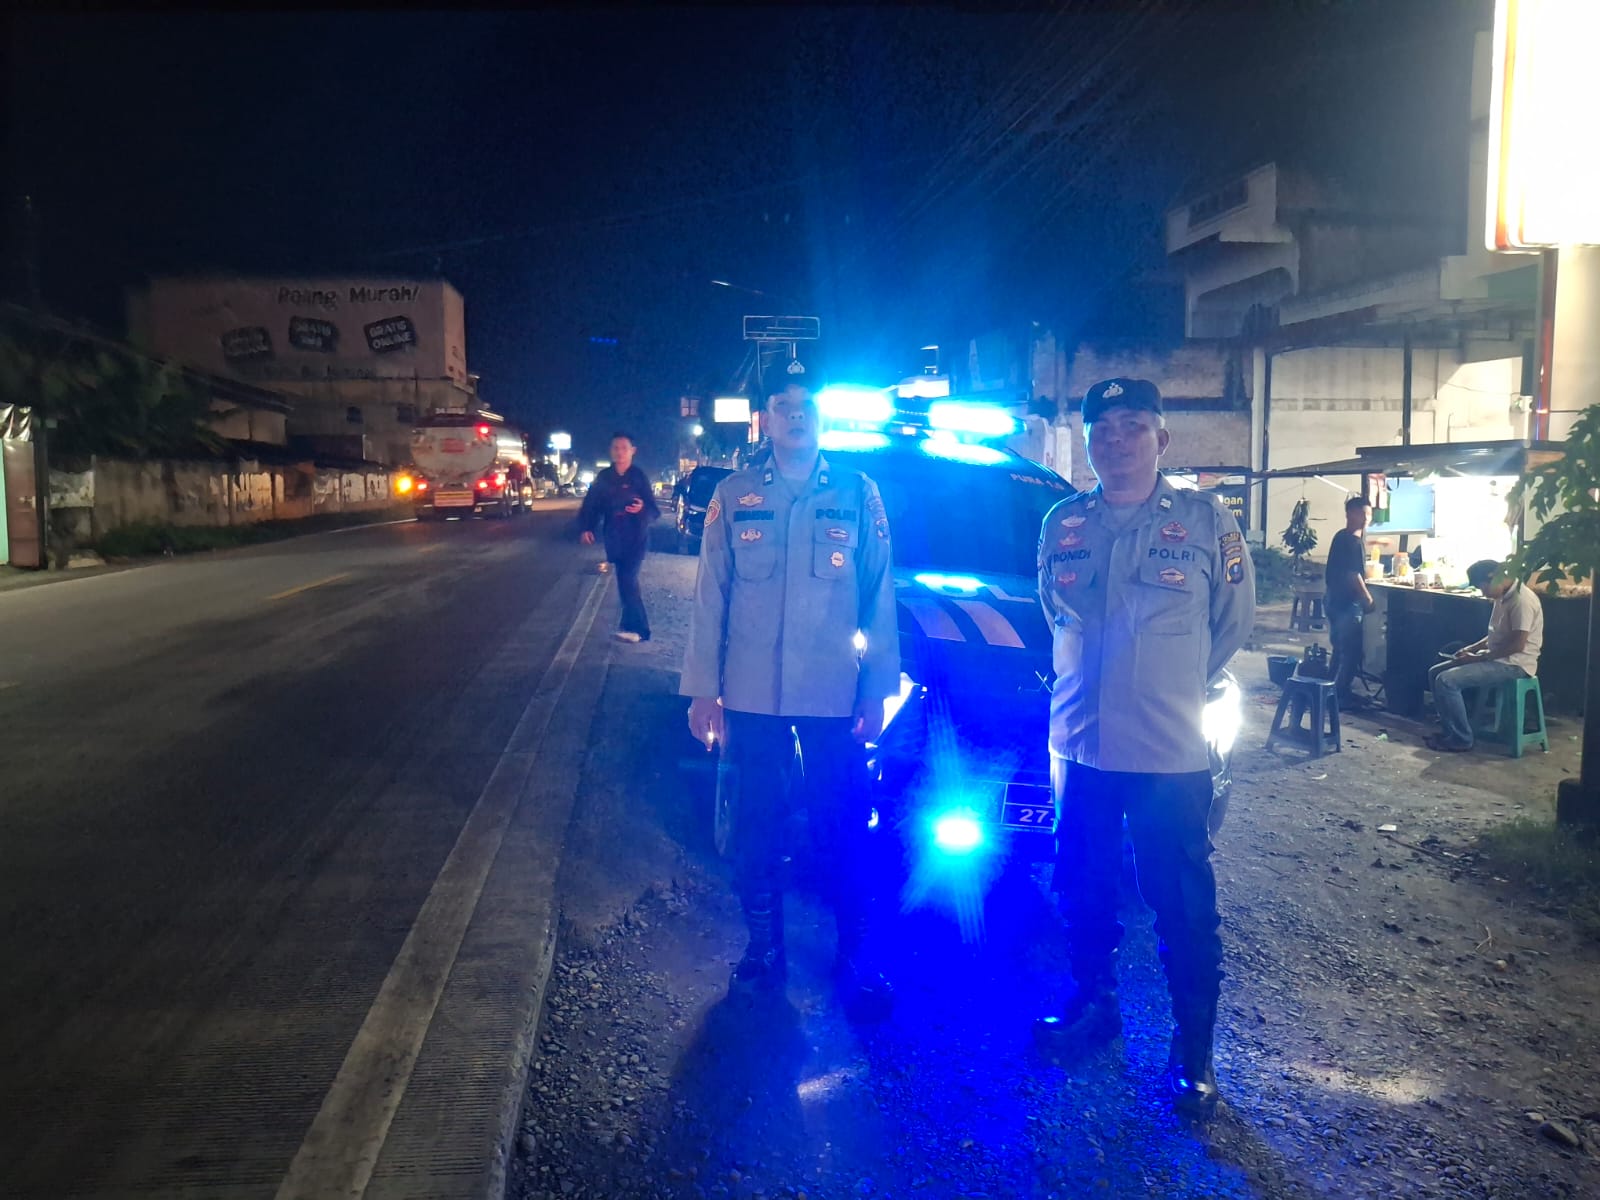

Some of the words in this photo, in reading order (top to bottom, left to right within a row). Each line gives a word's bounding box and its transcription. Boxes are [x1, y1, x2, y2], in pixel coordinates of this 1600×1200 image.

[278, 286, 338, 311] Paling
[1223, 496, 1243, 508] gan
[1148, 548, 1196, 562] POLRI
[1019, 808, 1054, 824] 27
